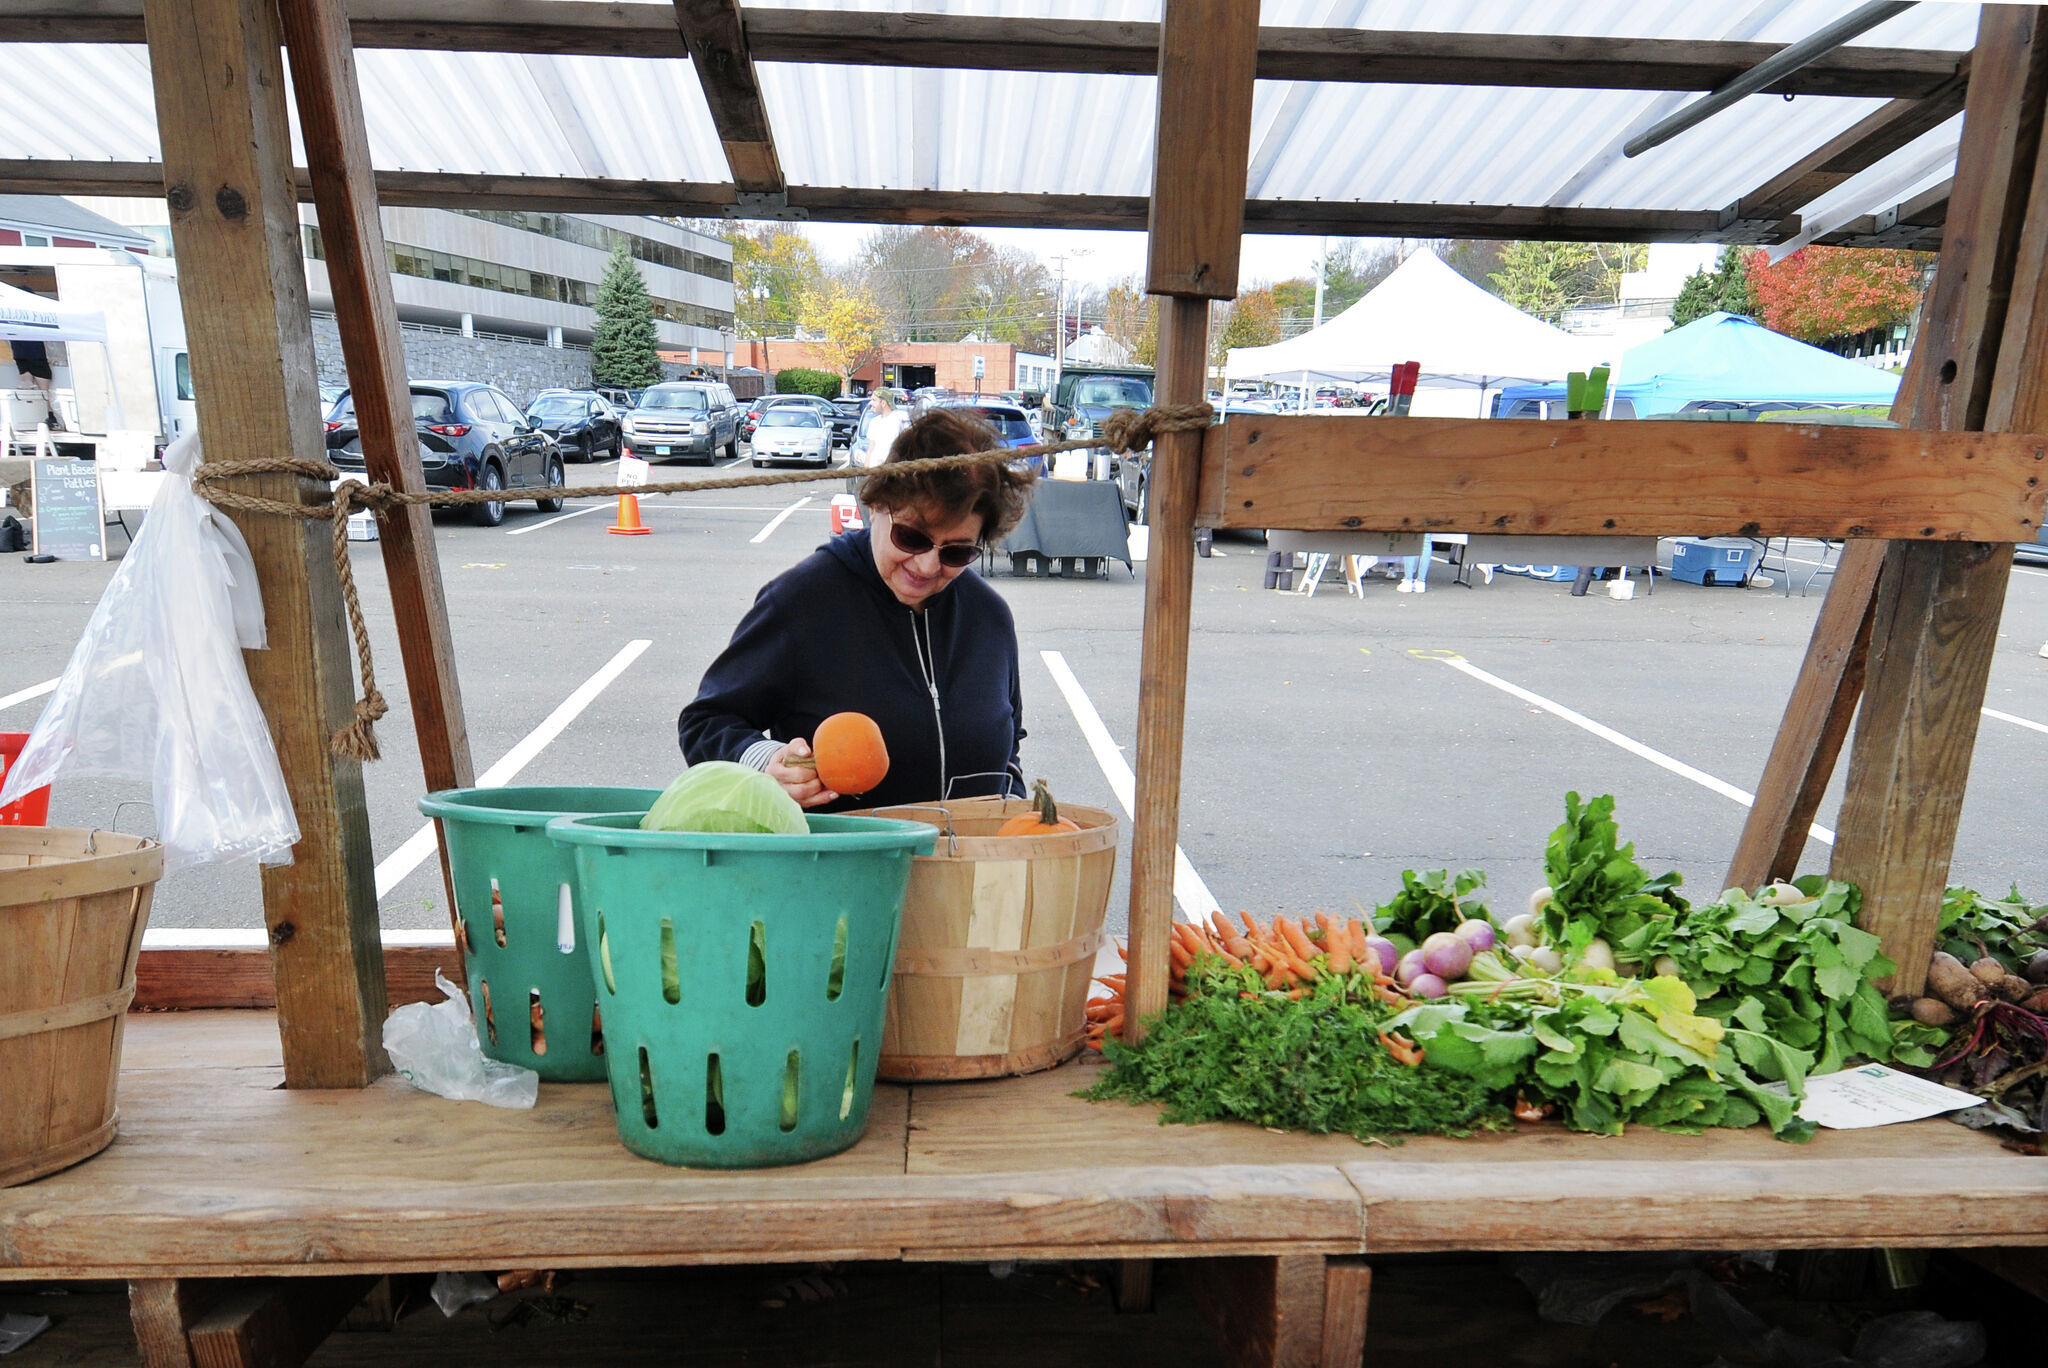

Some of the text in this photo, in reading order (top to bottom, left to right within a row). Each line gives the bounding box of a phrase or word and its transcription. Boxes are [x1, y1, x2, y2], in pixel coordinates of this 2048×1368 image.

[46, 463, 97, 476] Plant Based
[63, 477, 97, 489] Patties
